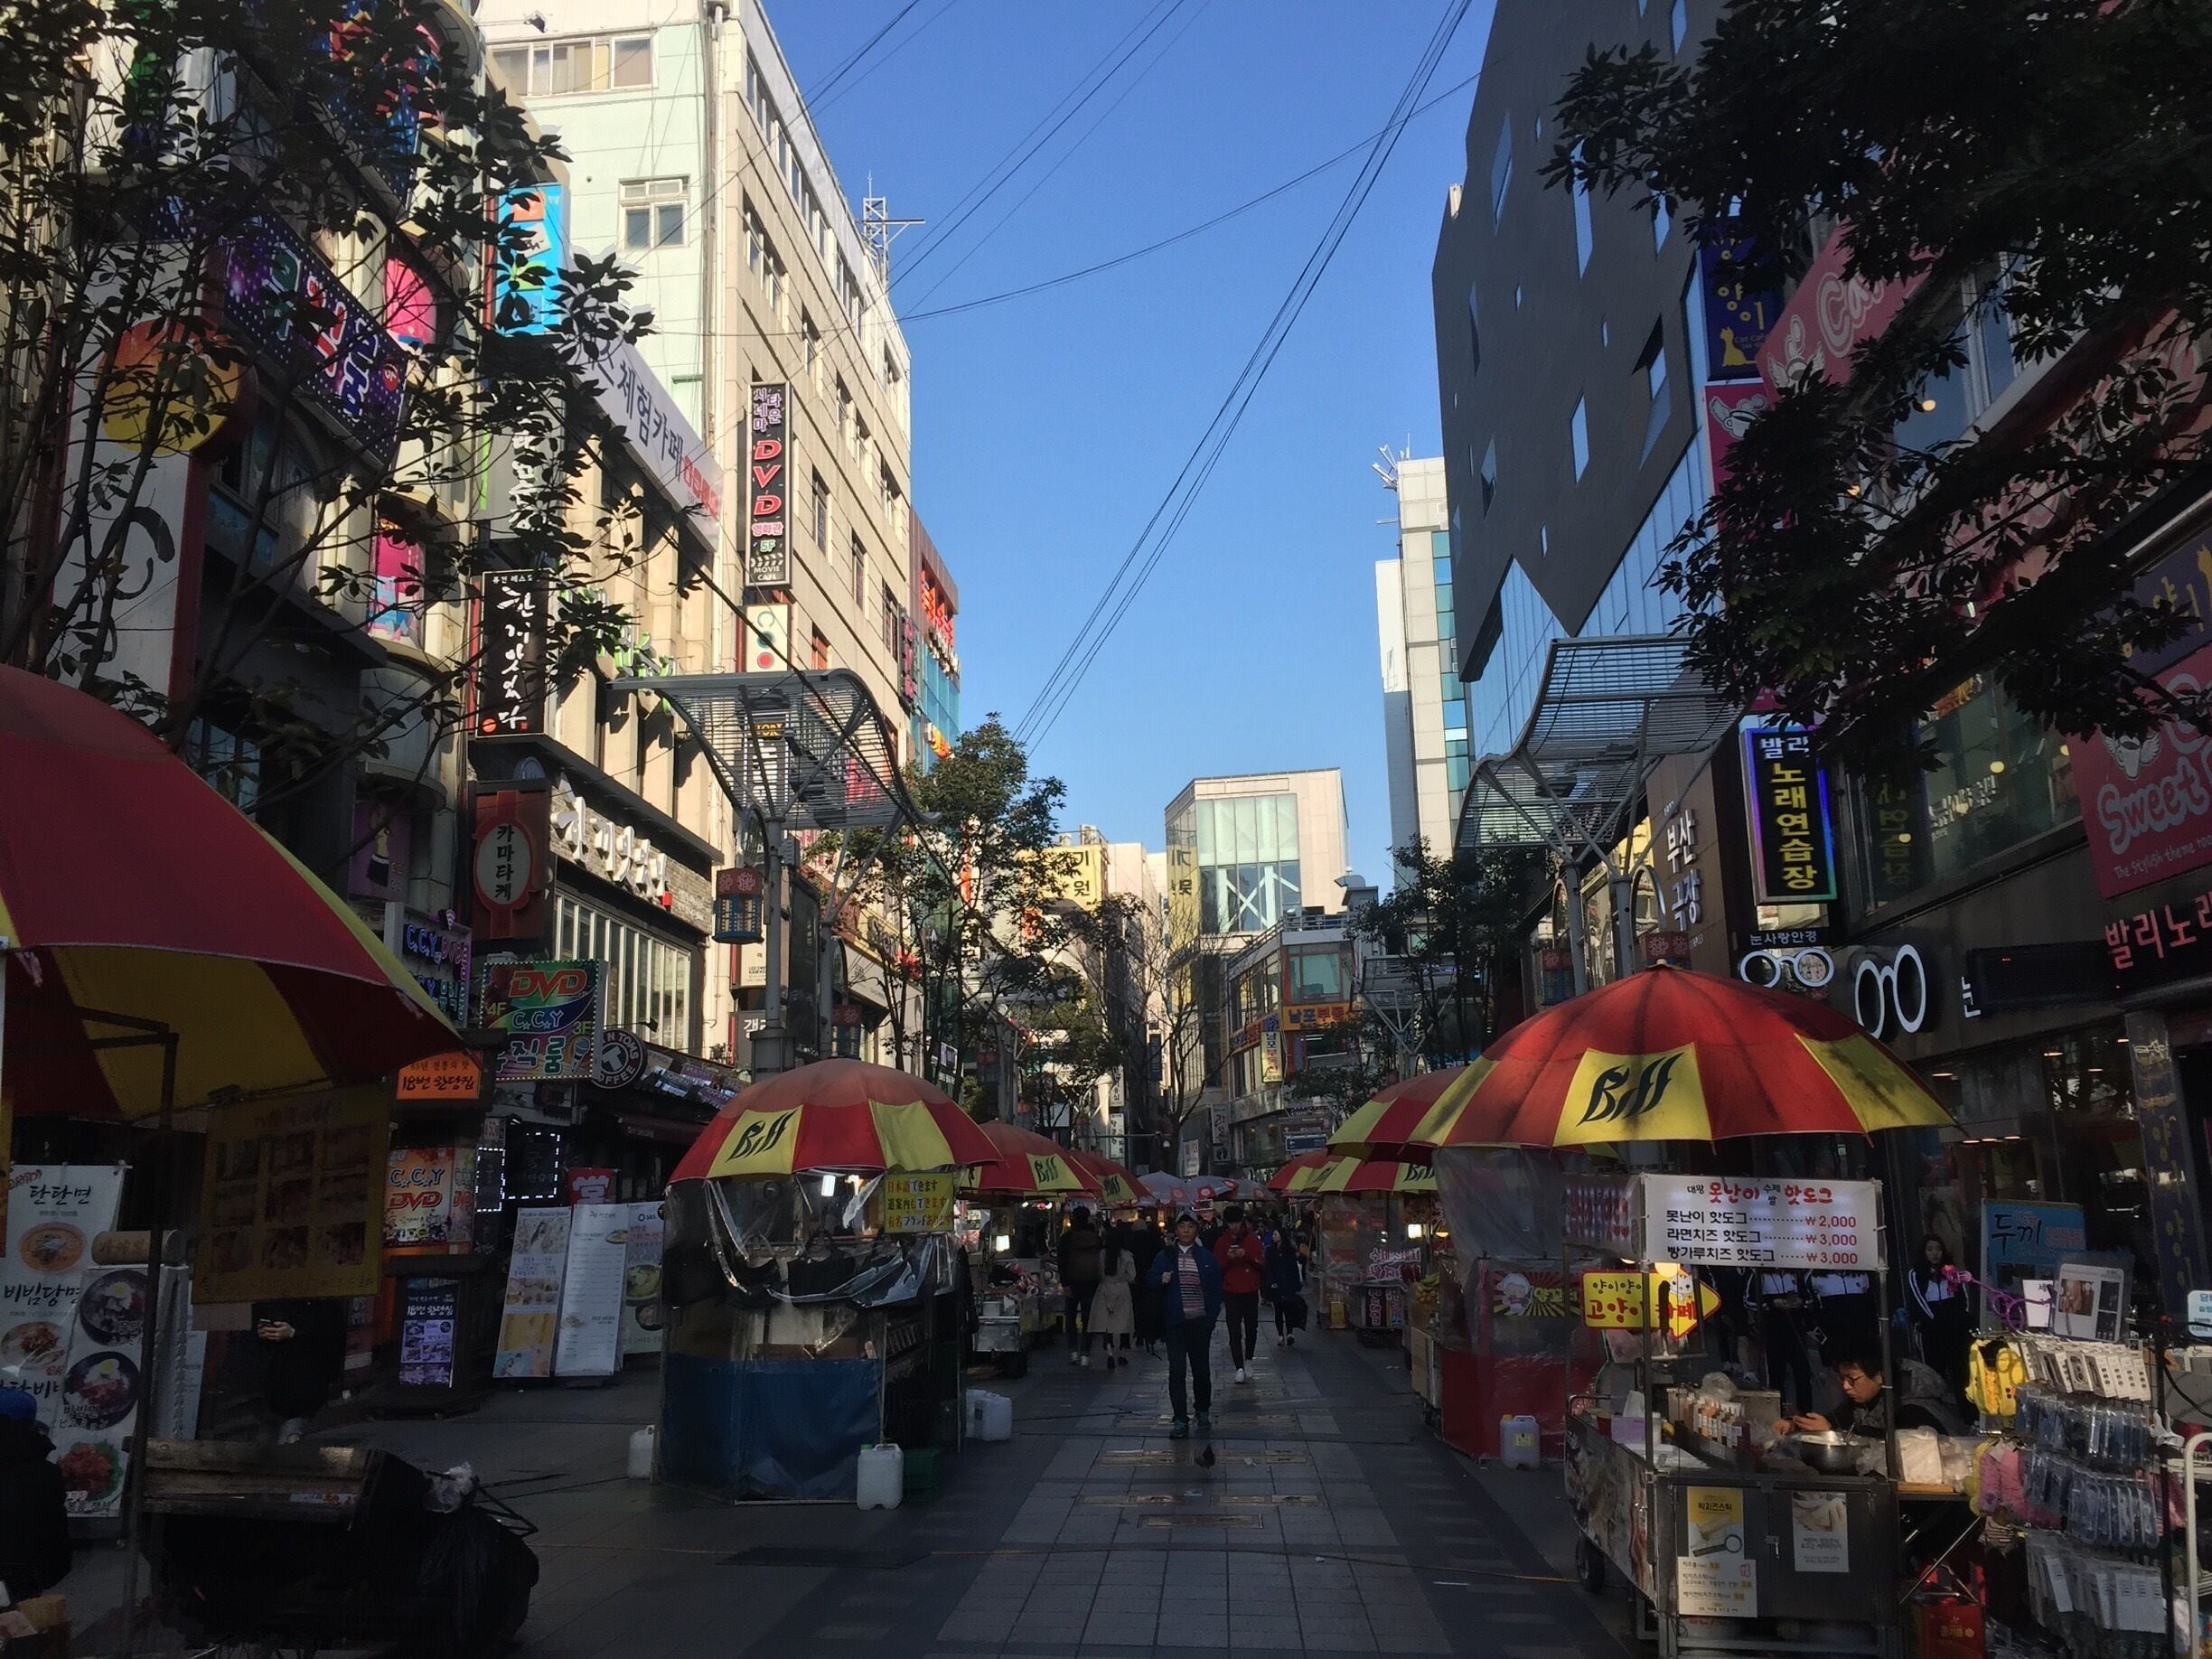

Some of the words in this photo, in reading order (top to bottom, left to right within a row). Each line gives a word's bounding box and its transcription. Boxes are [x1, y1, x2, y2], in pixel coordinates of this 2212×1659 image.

[753, 389, 768, 433] 시네마
[768, 393, 783, 425] 타운
[753, 439, 783, 516] DVD
[752, 521, 784, 538] 영화관
[760, 539, 777, 553] 5F
[754, 566, 781, 574] MOVIE
[2097, 756, 2210, 855] Sweet
[1771, 762, 1819, 890] 노래연습장
[1666, 809, 1697, 874] 부산
[495, 824, 515, 902] 카마타케
[1672, 867, 1701, 933] 극장
[1750, 931, 1818, 946] 눈사랑안경
[508, 969, 587, 1003] DVD
[488, 1002, 506, 1016] 4F
[573, 1021, 593, 1036] 3F
[30, 1184, 91, 1205] 탄탄면
[387, 1191, 443, 1211] DVD
[1687, 1185, 1704, 1195] 대왕
[1709, 1182, 1759, 1204] 못난이
[1763, 1184, 1781, 1194] 수제
[1785, 1184, 1833, 1205] 핫도그
[1666, 1210, 1704, 1223] 못난이
[1710, 1210, 1748, 1224] 핫도그
[1667, 1228, 1719, 1242] 라면치즈
[1723, 1229, 1761, 1243] 핫도그
[1992, 1214, 2042, 1256] 두끼
[1667, 1246, 1732, 1261] 빵가루치즈
[1737, 1247, 1776, 1261] 핫도그
